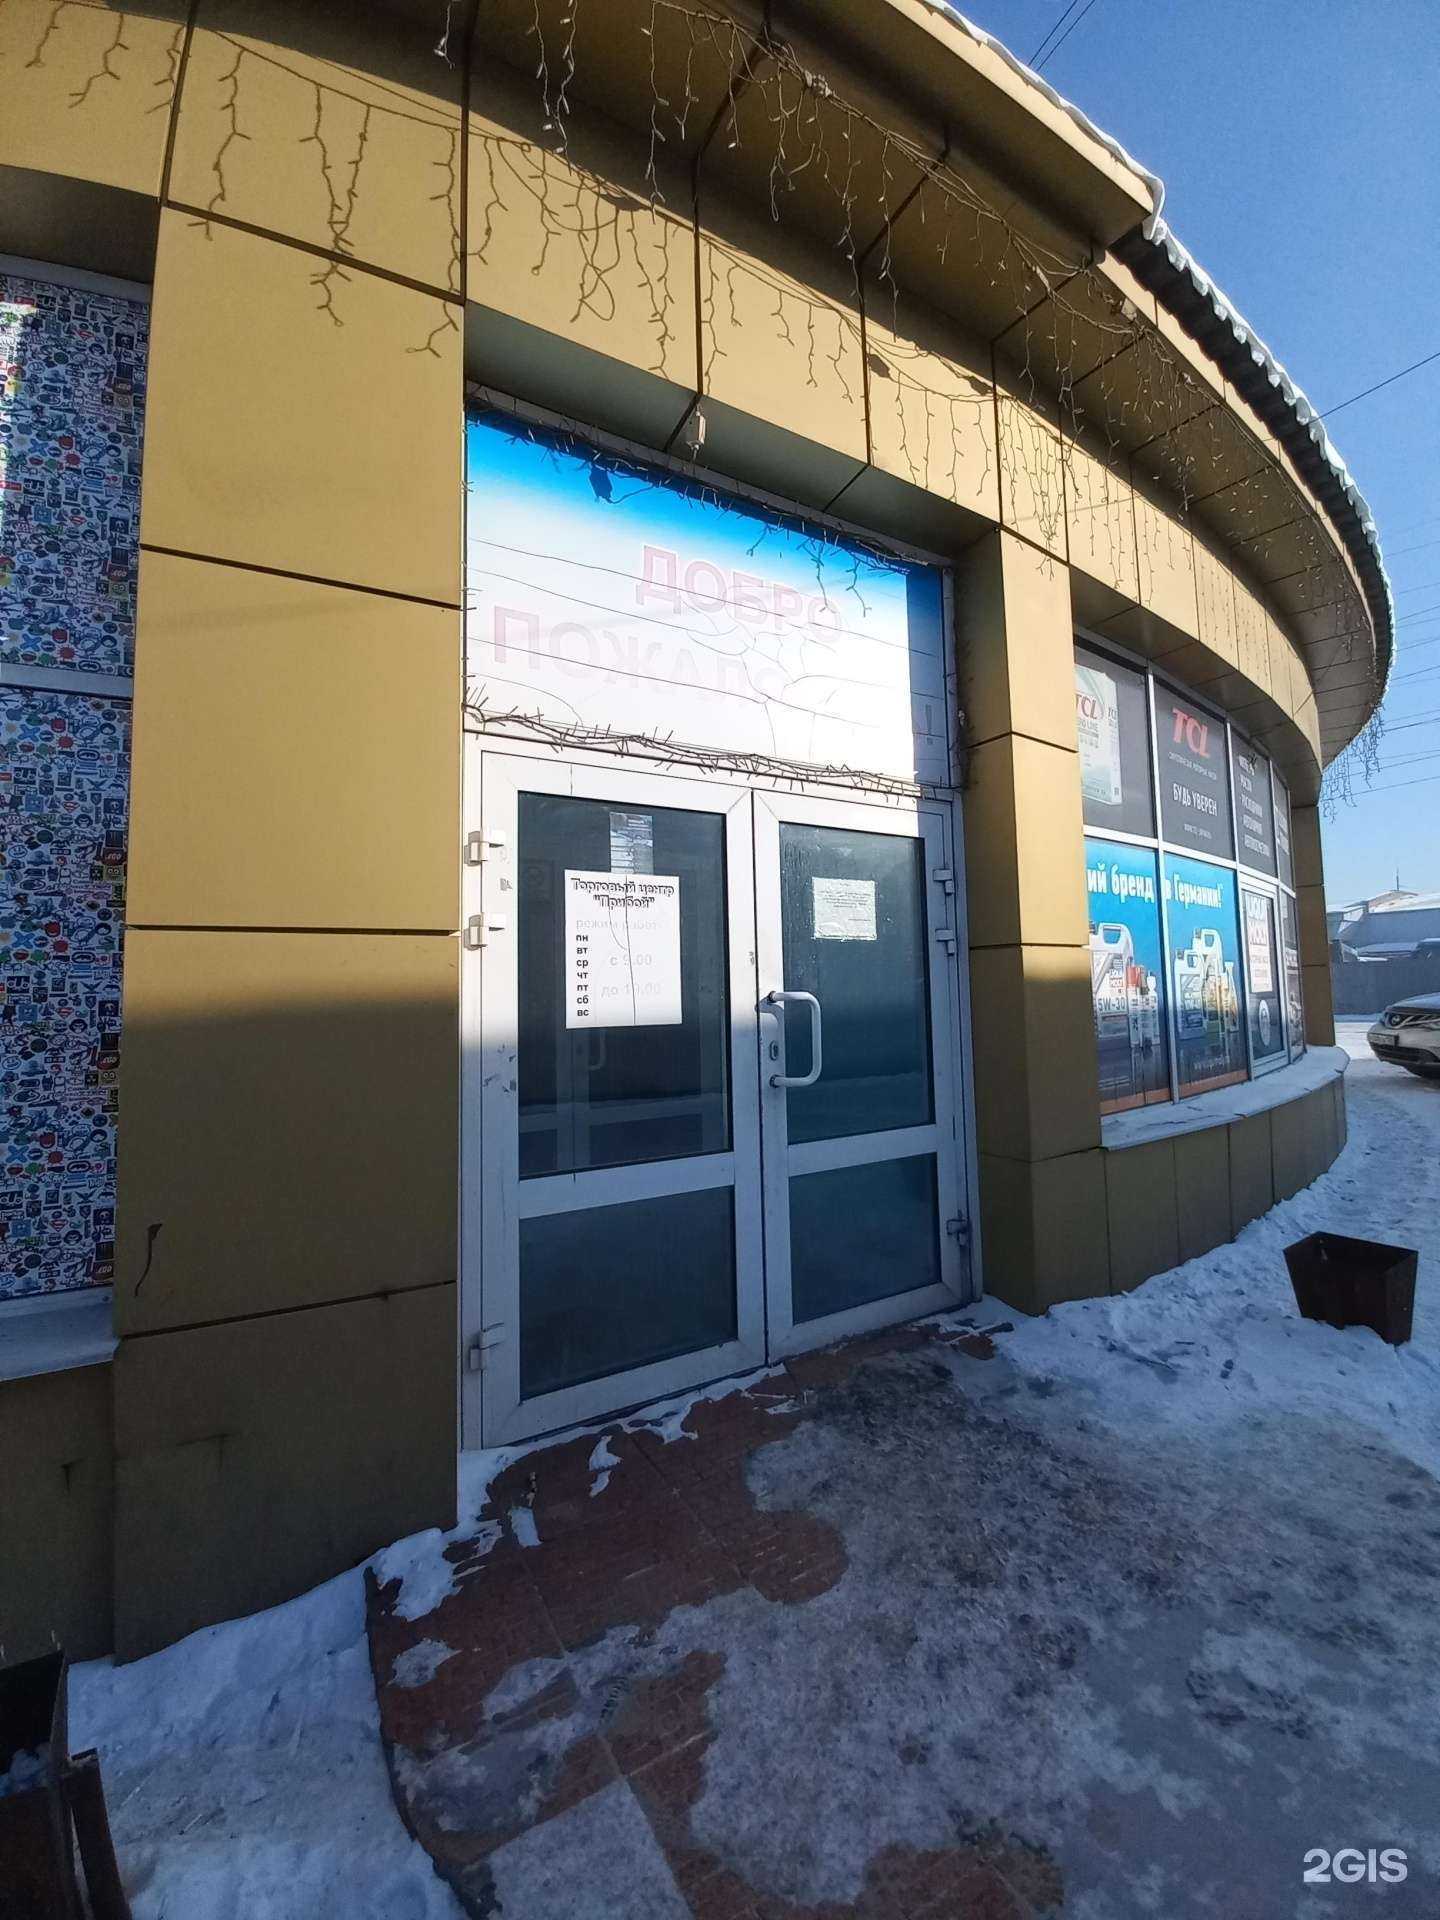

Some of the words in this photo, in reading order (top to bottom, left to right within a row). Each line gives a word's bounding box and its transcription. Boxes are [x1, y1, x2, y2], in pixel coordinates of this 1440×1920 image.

[635, 544, 843, 642] ДОБРО
[1172, 707, 1210, 758] TCL
[1173, 783, 1191, 806] БУДЬ
[1191, 791, 1218, 816] УВЕРЕН
[571, 878, 636, 893] Торговый
[639, 884, 675, 897] центр
[1111, 864, 1154, 903] бренд
[576, 947, 588, 955] вт
[576, 960, 589, 969] ср
[576, 995, 589, 1004] сб
[1097, 996, 1126, 1012] 5W-30
[576, 1009, 590, 1017] вс
